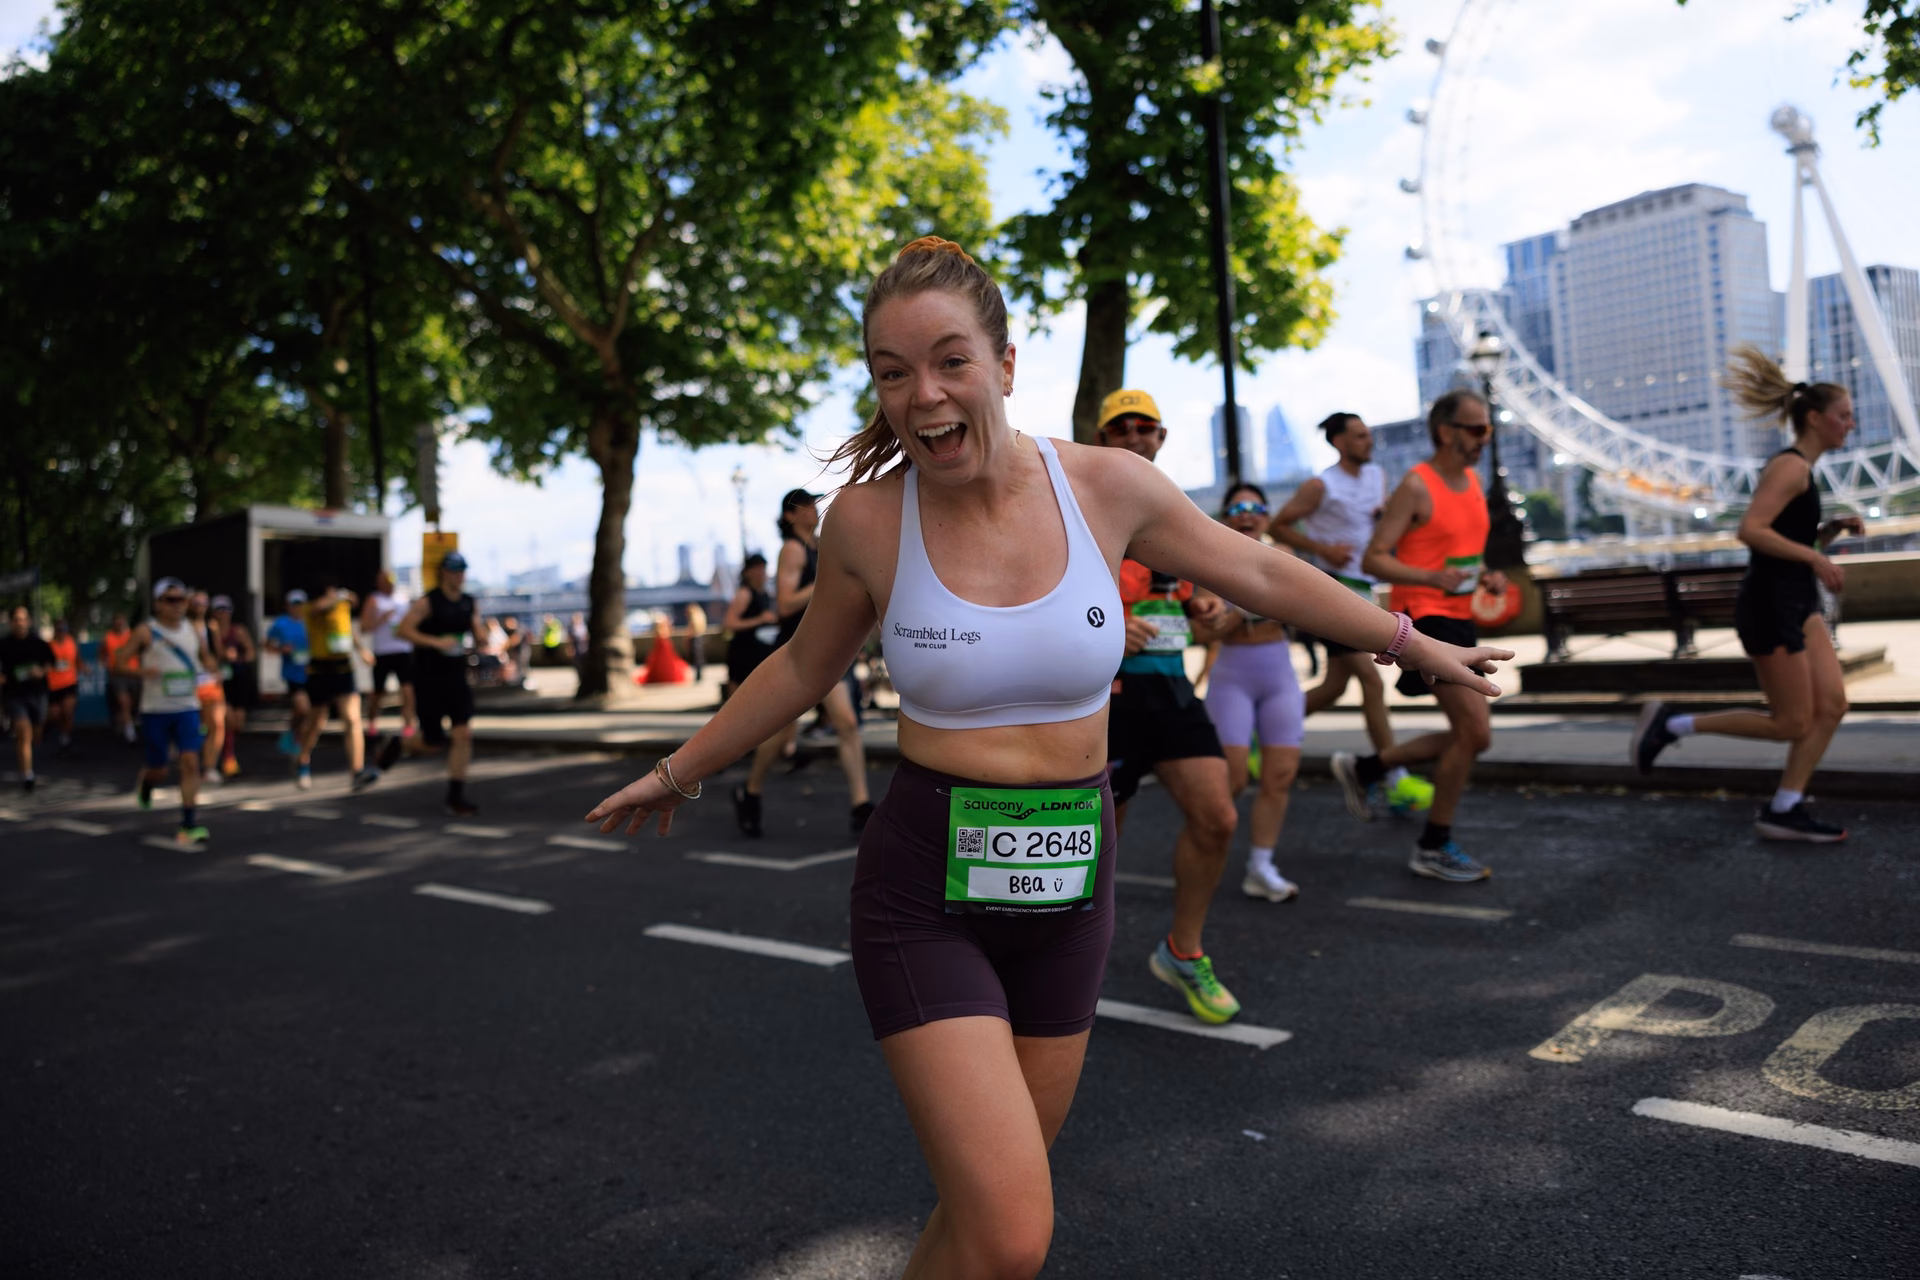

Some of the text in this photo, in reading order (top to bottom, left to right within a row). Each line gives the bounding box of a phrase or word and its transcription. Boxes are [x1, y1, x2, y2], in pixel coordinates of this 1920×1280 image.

[894, 622, 982, 645] Scrambled Legs
[963, 799, 1094, 813] saucony LDN 10K
[992, 829, 1092, 858] C 2648
[1009, 875, 1046, 894] Bea
